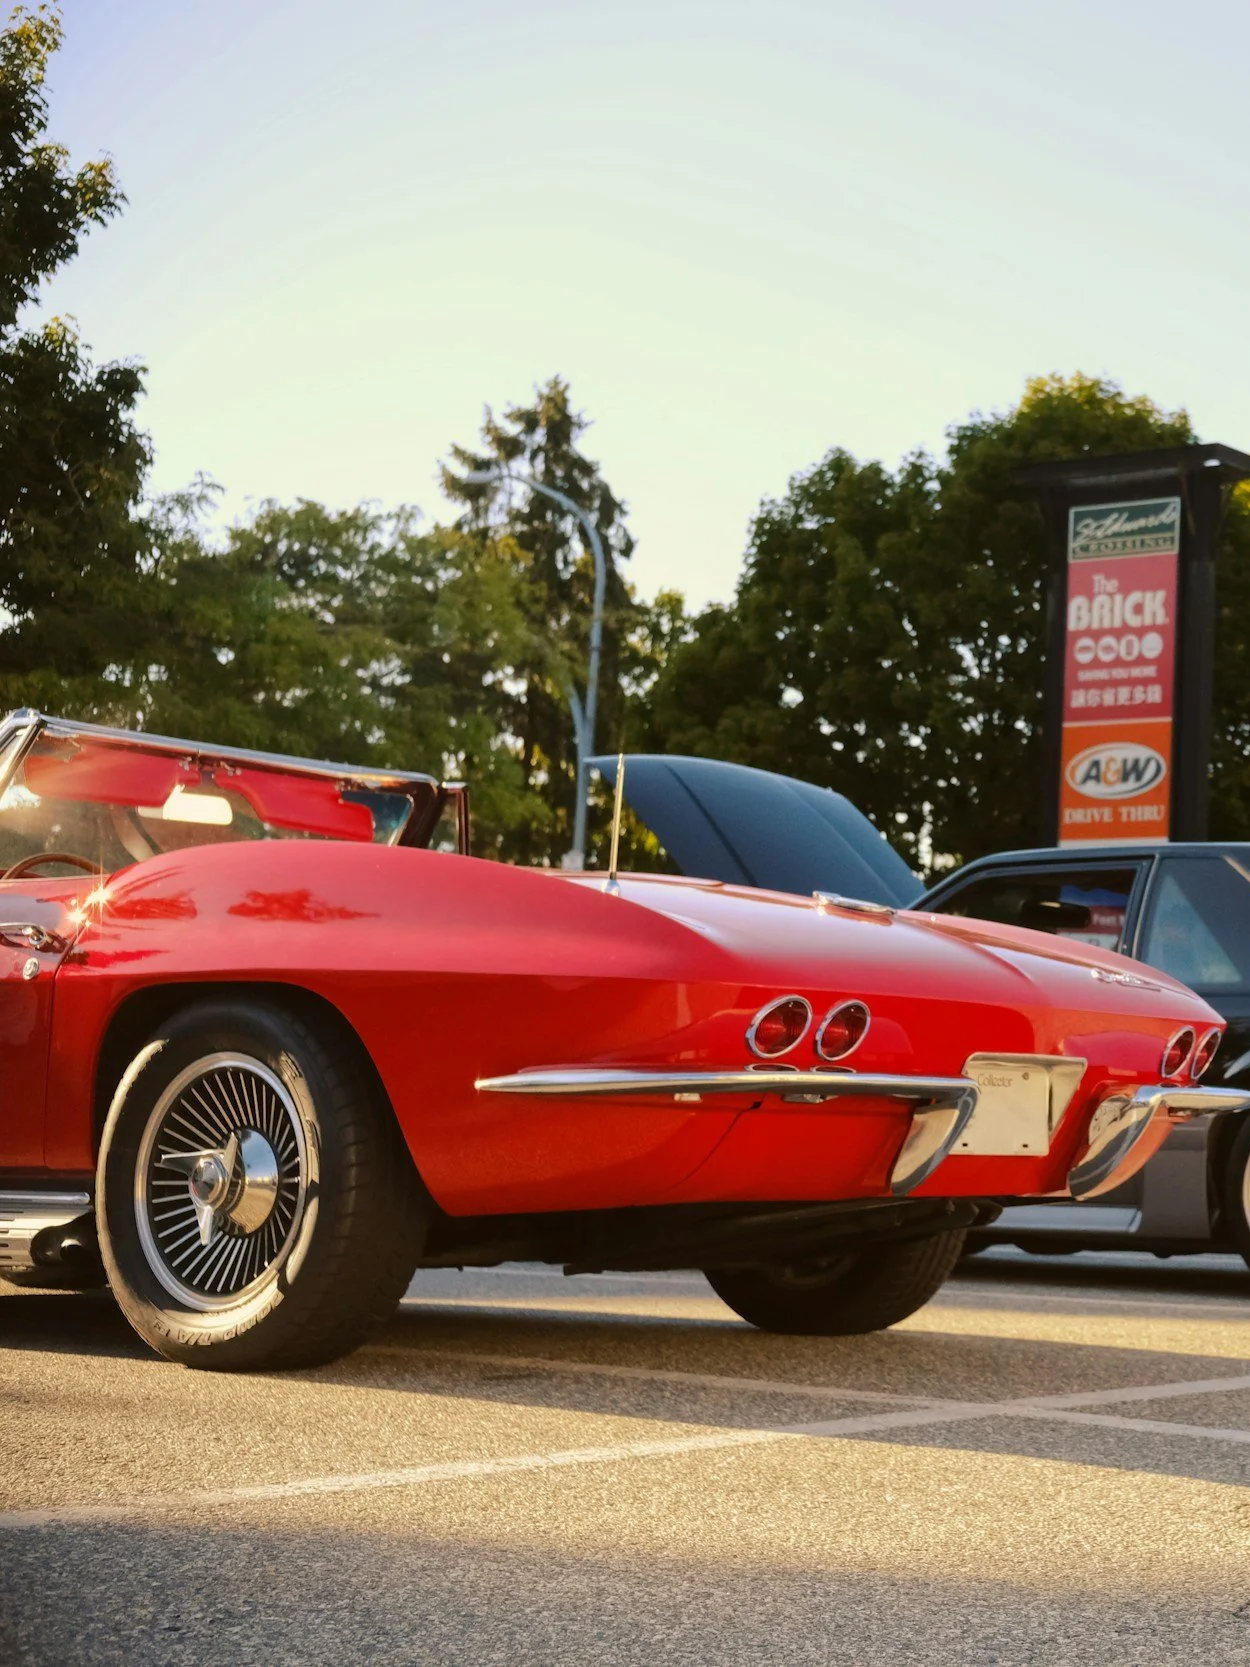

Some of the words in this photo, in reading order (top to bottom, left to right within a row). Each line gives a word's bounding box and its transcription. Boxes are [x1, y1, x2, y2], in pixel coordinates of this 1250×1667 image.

[1092, 573, 1119, 594] The
[1068, 590, 1167, 632] BRICK
[1079, 755, 1157, 787] A&W
[1064, 807, 1113, 824] DRIVE
[1119, 805, 1165, 822] THRU
